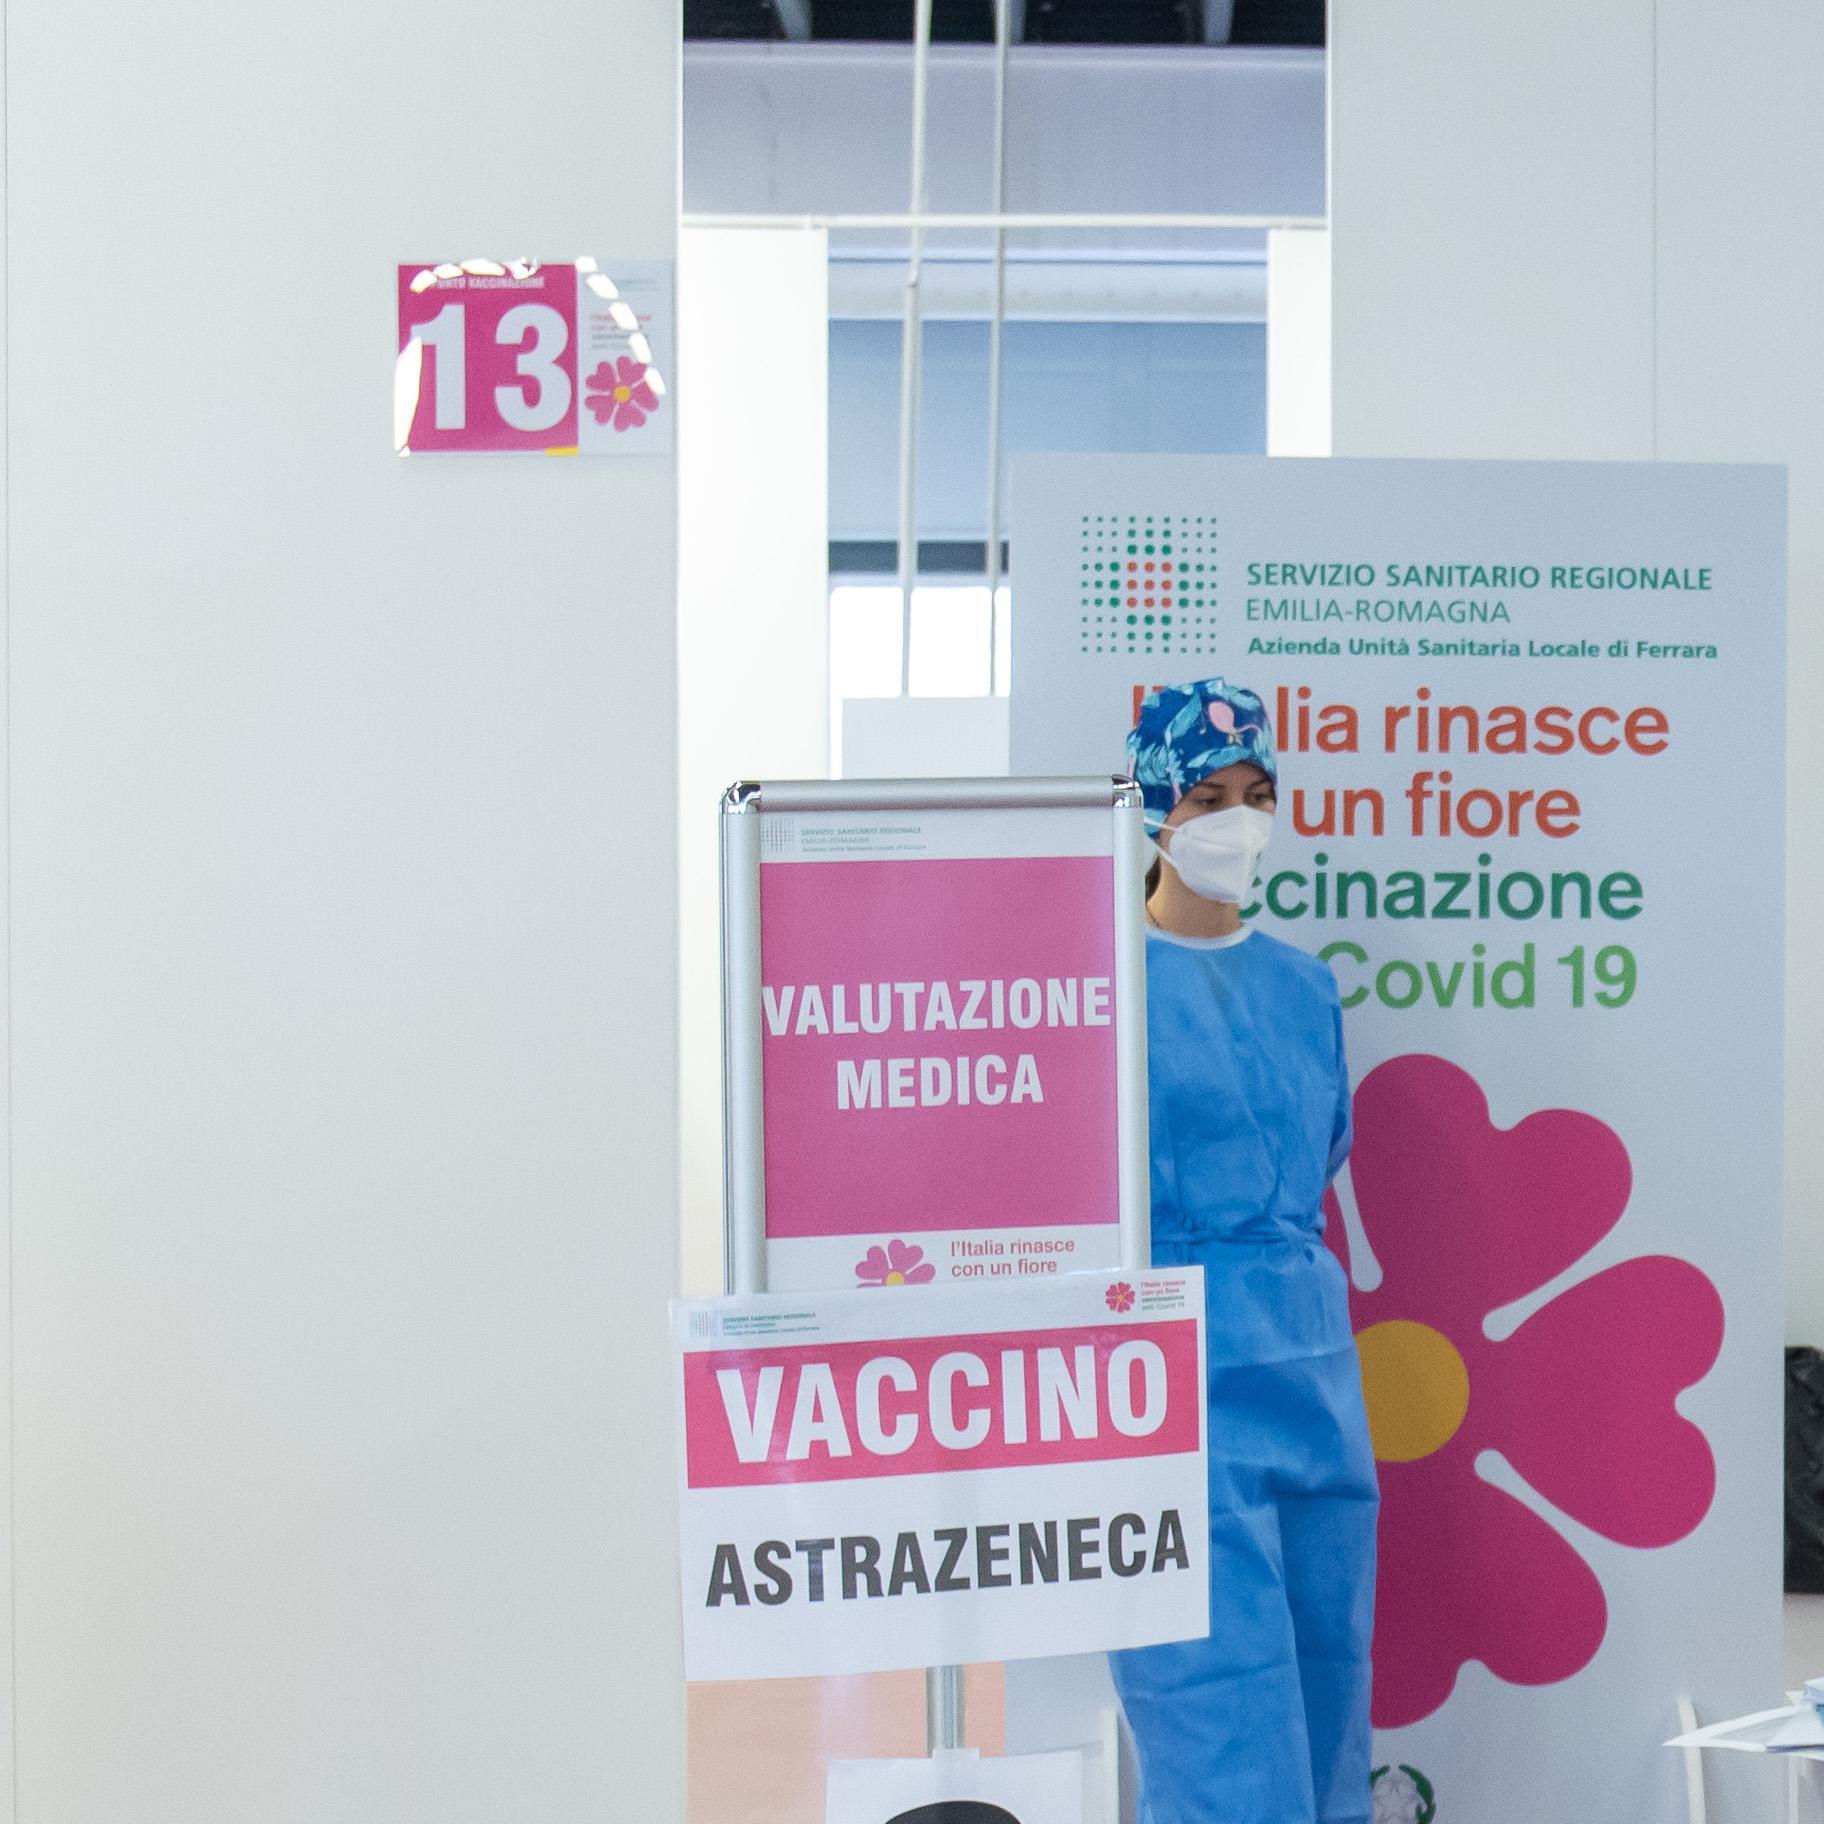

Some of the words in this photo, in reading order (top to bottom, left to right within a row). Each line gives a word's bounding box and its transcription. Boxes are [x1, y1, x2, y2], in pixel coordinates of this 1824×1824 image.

[411, 304, 571, 431] 13
[1247, 562, 1376, 587] SERVIZIO
[1386, 564, 1541, 589] SANITARIO
[1550, 566, 1712, 591] REGIONALE
[1246, 598, 1511, 624] EMILIA-ROMAGNA
[1247, 636, 1341, 656] Azienda
[1348, 637, 1410, 656] Unità
[1417, 638, 1521, 657] Sanitaria
[1528, 639, 1601, 658] Locale
[1607, 639, 1629, 658] di
[1636, 640, 1718, 659] Ferrara
[1385, 687, 1668, 755] rinasce
[1293, 789, 1383, 837] un
[1406, 771, 1580, 838] fiore
[1558, 945, 1636, 1008] 19
[763, 977, 1111, 1036] VALUTAZIONE
[836, 1054, 1044, 1110] MEDICA
[951, 1263, 985, 1278] con
[990, 1262, 1012, 1276] un
[1017, 1258, 1058, 1275] fiore
[1009, 1239, 1076, 1255] rinasce
[716, 1340, 1168, 1464] VACCINO
[706, 1509, 1190, 1608] ASTRAZENECA
